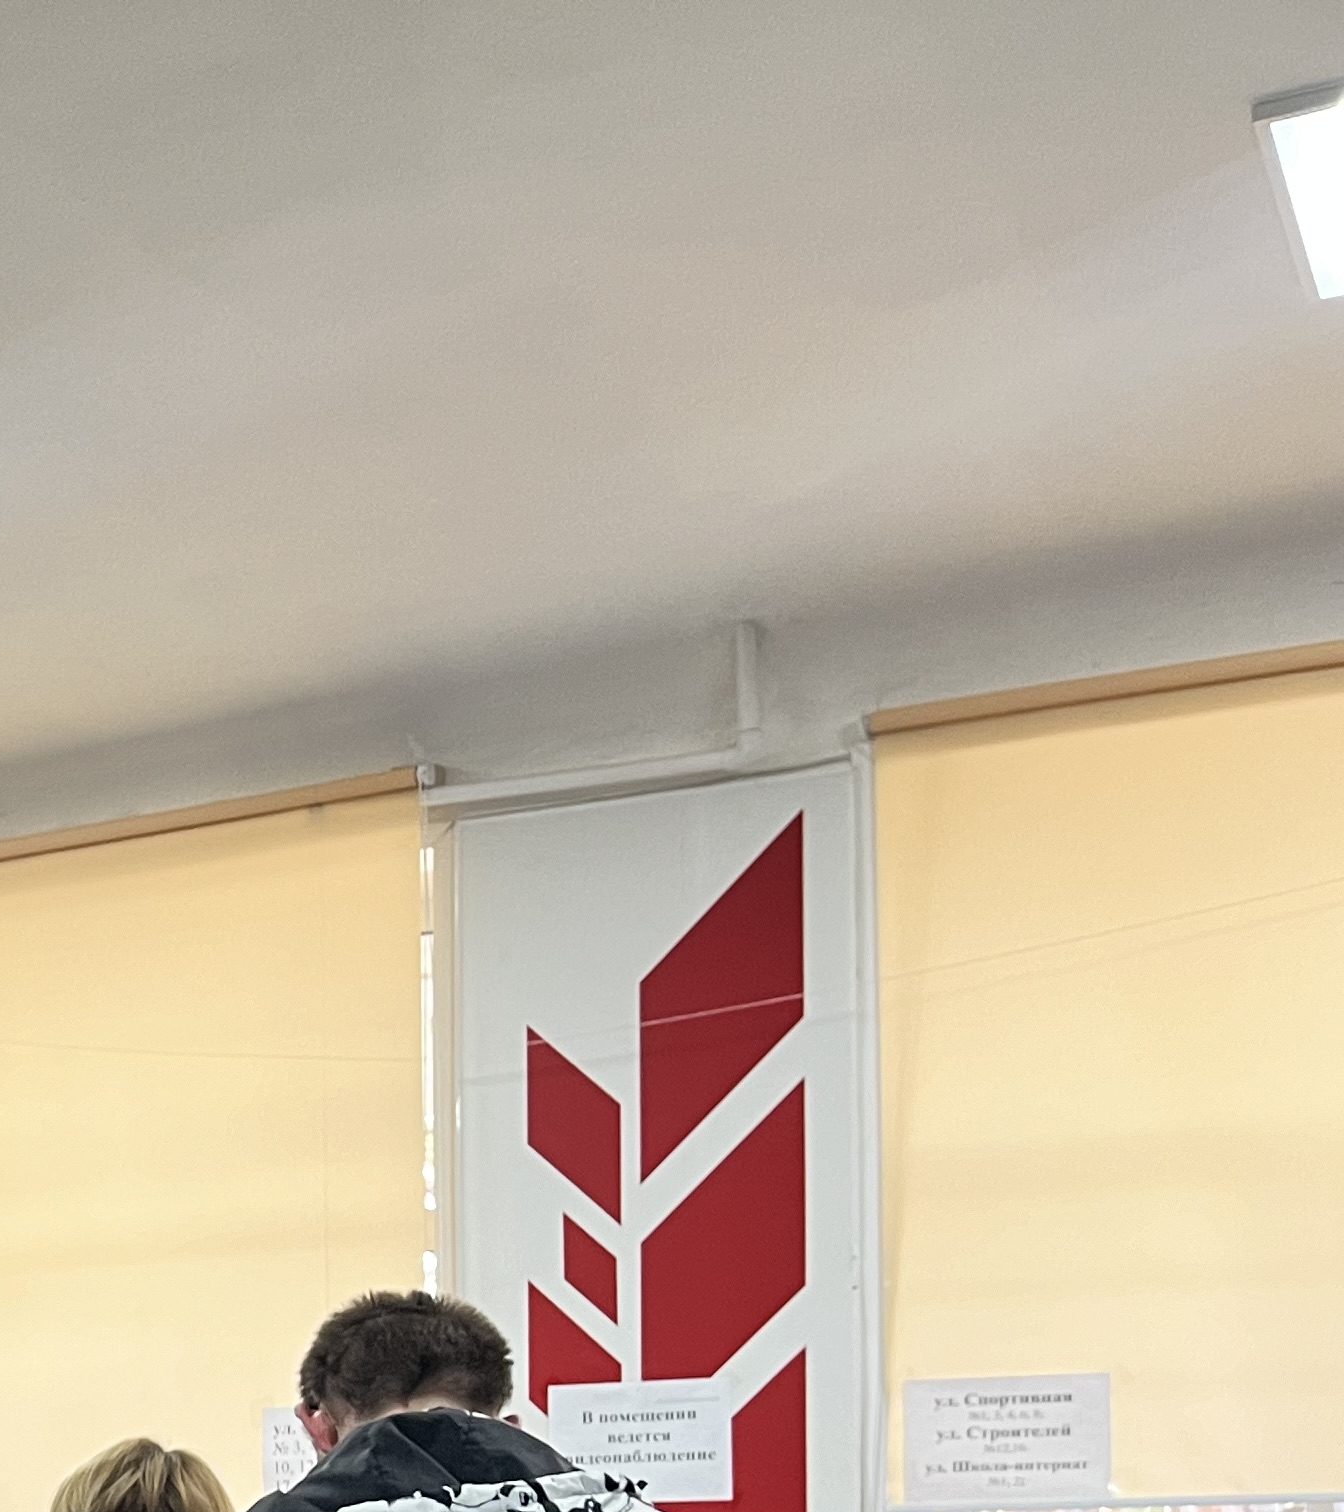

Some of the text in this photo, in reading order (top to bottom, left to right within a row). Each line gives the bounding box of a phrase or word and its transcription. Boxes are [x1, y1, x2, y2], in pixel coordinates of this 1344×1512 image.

[964, 1392, 1073, 1409] Спортивная
[582, 1410, 697, 1424] В помещении
[966, 1422, 1071, 1441] Строителей
